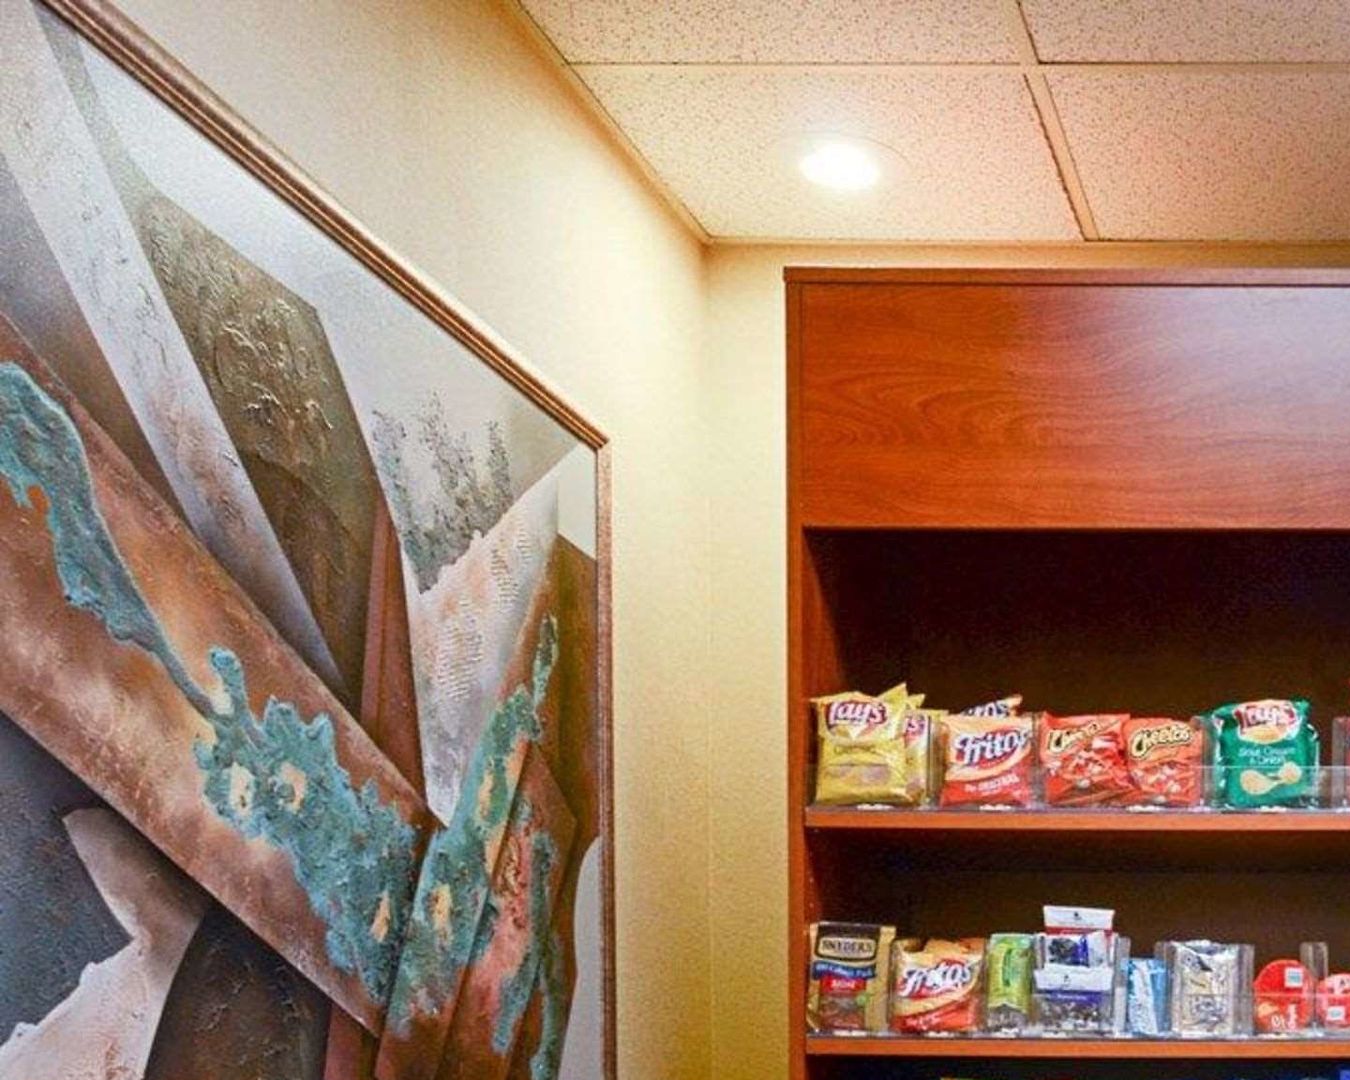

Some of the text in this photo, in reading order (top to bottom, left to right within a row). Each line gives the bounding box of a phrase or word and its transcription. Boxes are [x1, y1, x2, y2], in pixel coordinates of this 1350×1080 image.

[827, 701, 888, 727] Lay's
[954, 729, 1029, 766] Fritos
[1131, 722, 1193, 757] Cheetos
